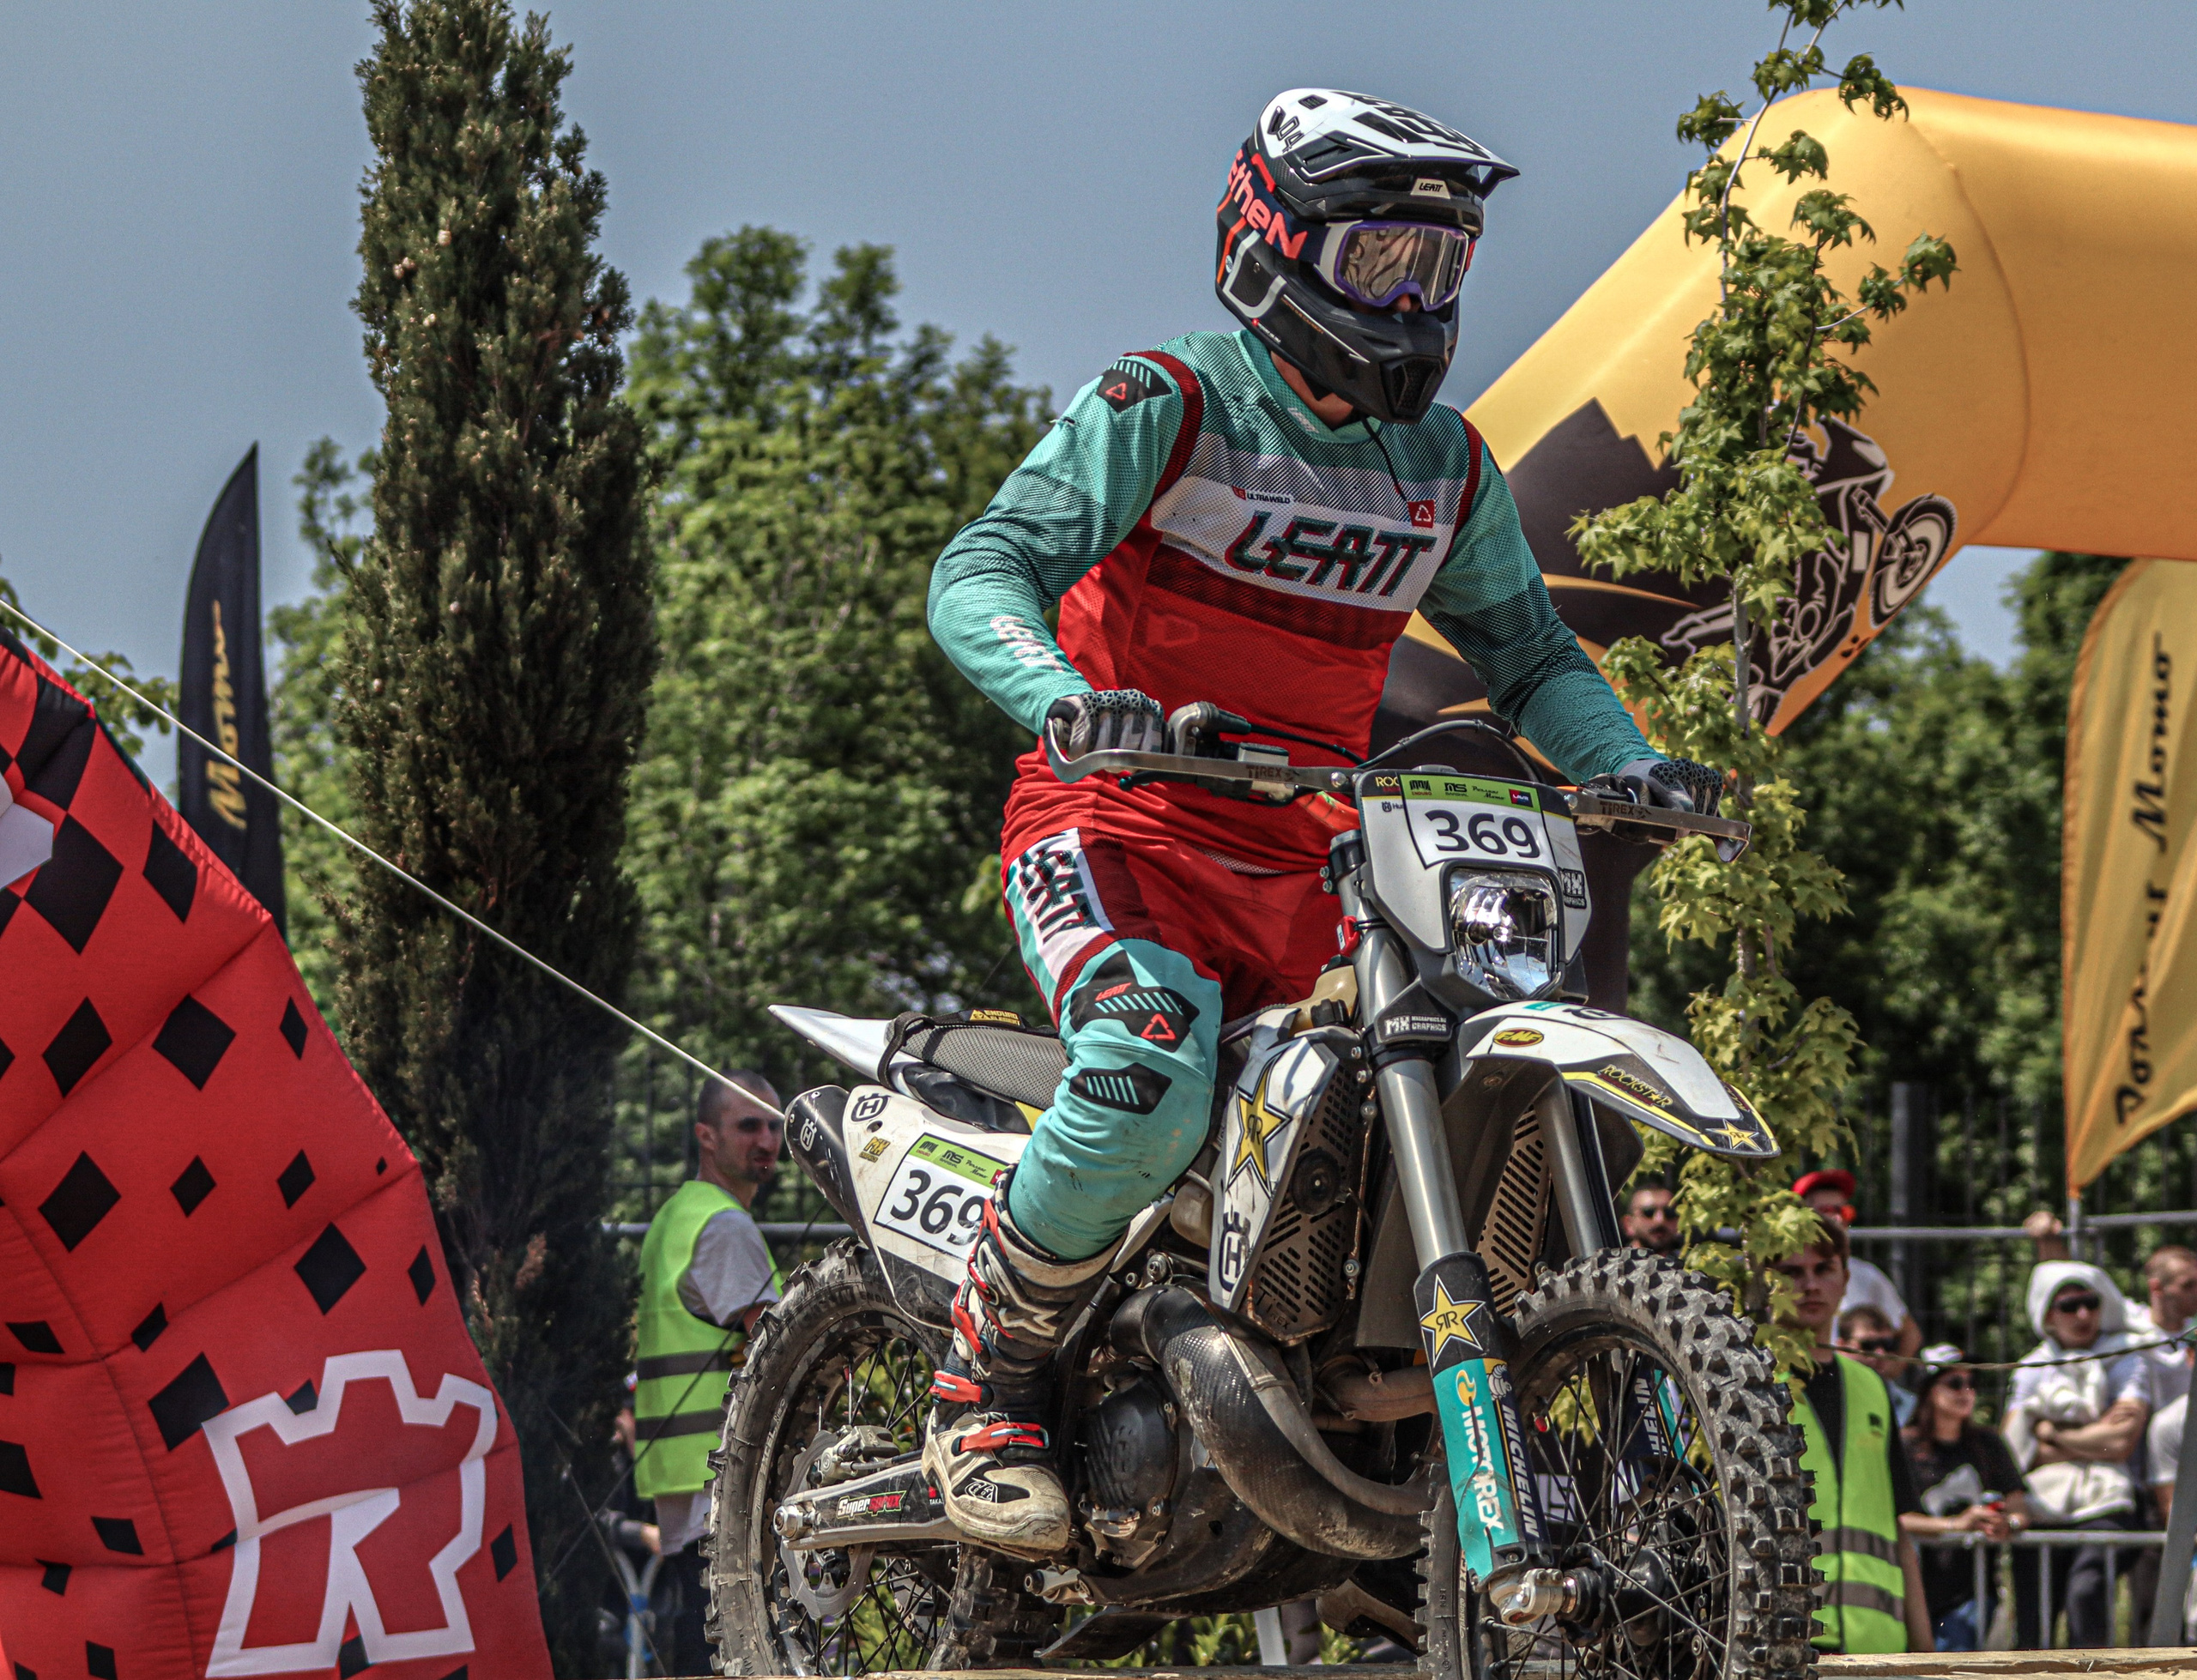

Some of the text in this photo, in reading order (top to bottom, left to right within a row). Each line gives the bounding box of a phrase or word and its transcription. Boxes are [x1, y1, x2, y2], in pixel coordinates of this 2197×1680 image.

[1419, 182, 1443, 193] LEATT
[1225, 511, 1438, 596] LEATT
[1425, 809, 1540, 858] 369
[1095, 982, 1132, 1002] LEATT
[1411, 1022, 1447, 1032] GRAPHICS
[1498, 1030, 1542, 1043] FMF
[890, 1169, 986, 1246] 369
[1461, 1405, 1505, 1531] MOTOREX
[1500, 1404, 1541, 1538] MICHELIN
